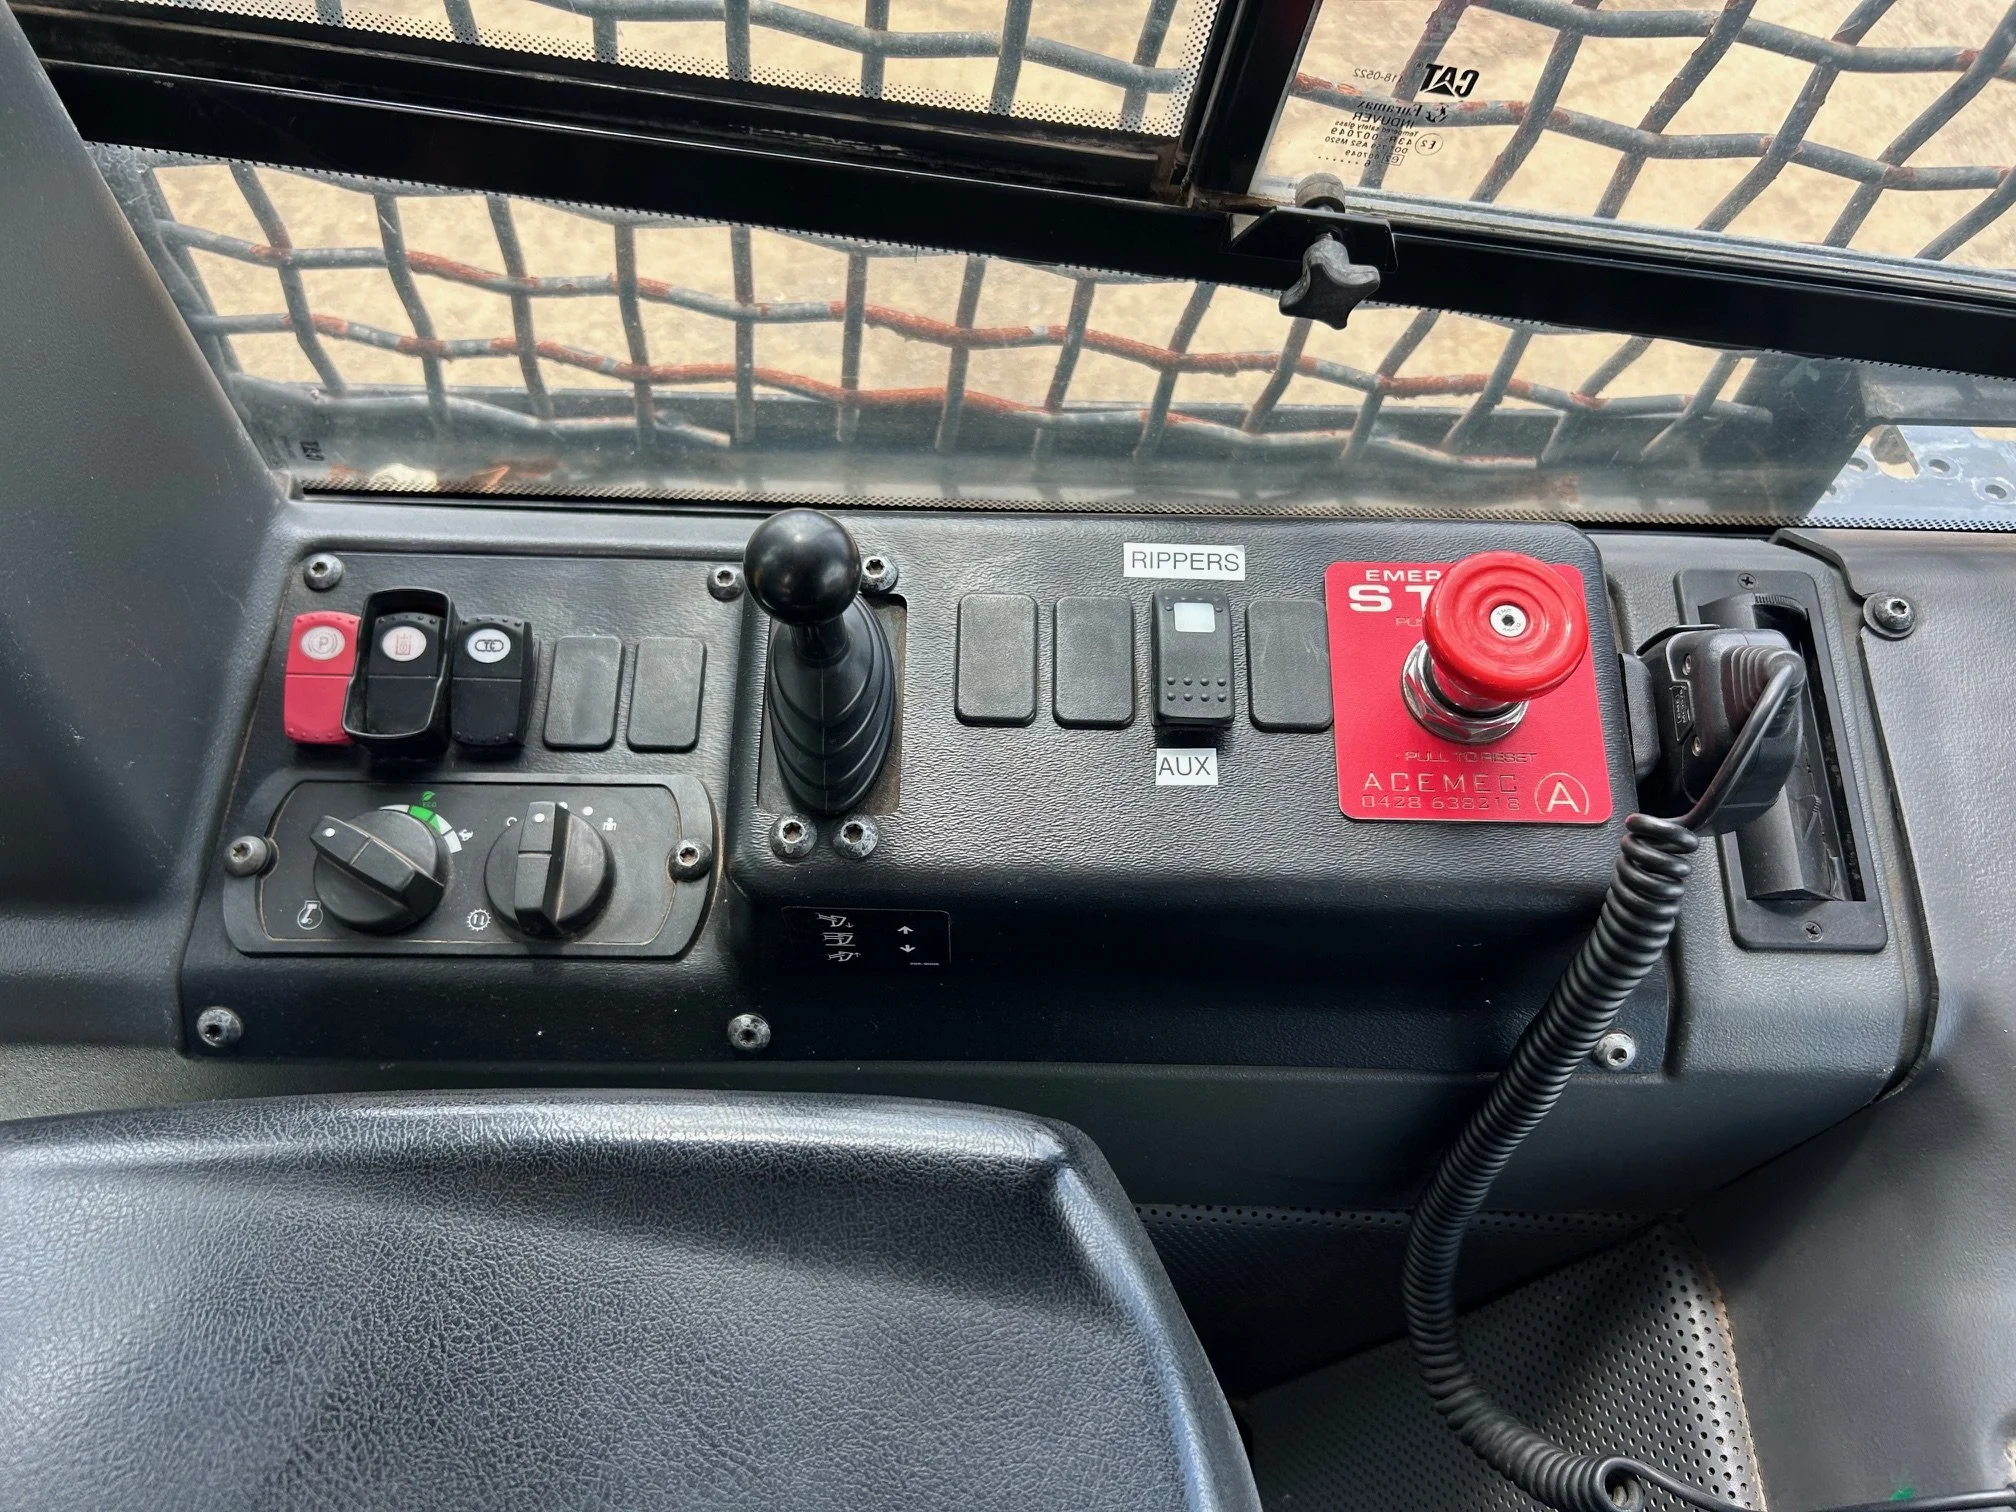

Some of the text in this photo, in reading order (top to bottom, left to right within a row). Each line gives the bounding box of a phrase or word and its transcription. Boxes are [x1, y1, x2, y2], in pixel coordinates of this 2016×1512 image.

[1132, 550, 1240, 572] RIPPERS
[1159, 756, 1210, 776] AUX
[1405, 751, 1537, 763] PULL TO RESET
[1363, 772, 1518, 793] ACEMEC
[1362, 795, 1421, 808] 0428
